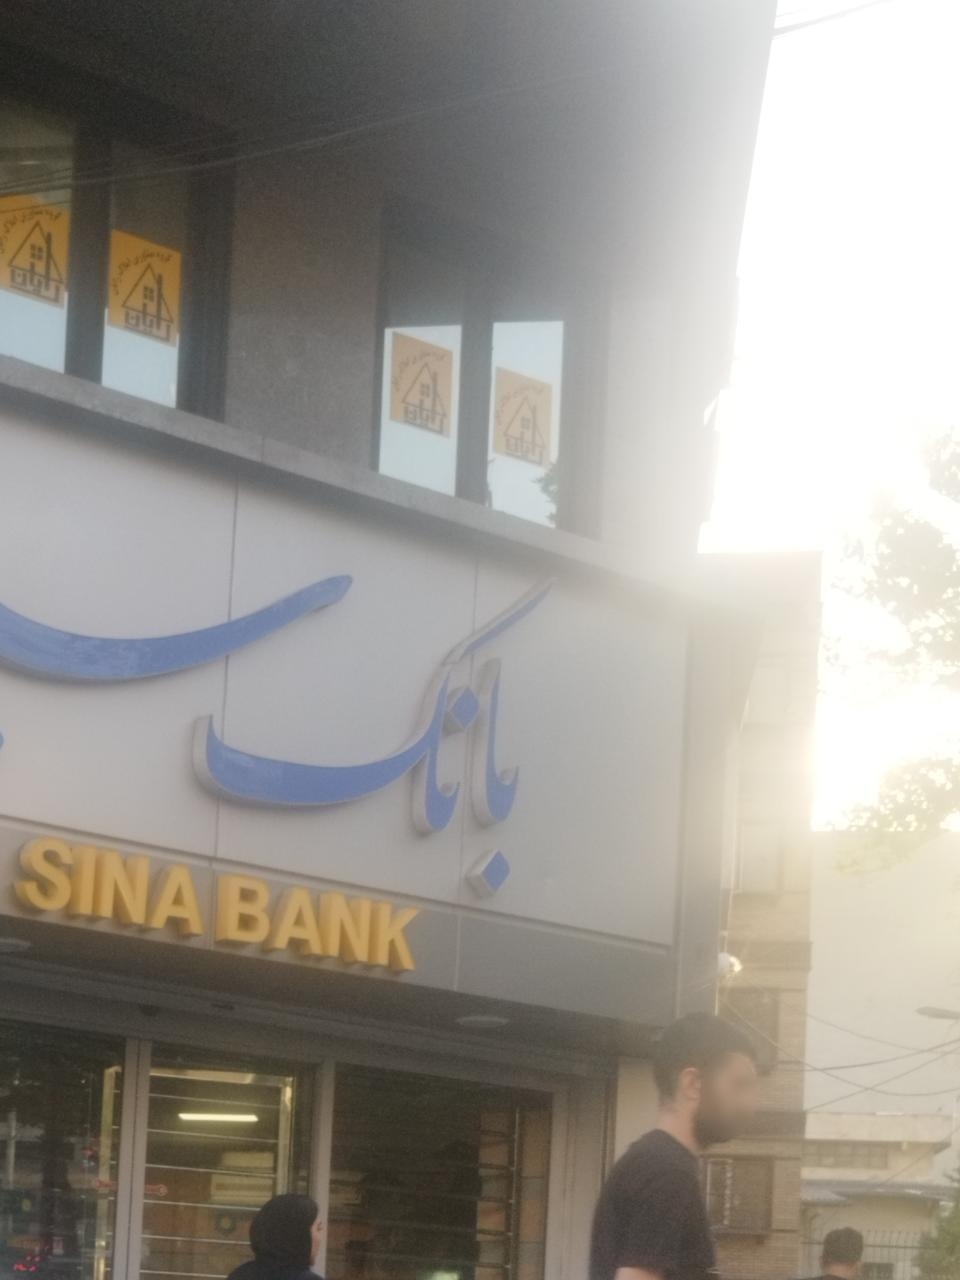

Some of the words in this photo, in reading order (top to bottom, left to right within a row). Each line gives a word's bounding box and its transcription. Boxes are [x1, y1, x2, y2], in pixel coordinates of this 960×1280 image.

[192, 577, 555, 898] بانک
[13, 836, 204, 938] SINA
[215, 872, 421, 972] BANK
